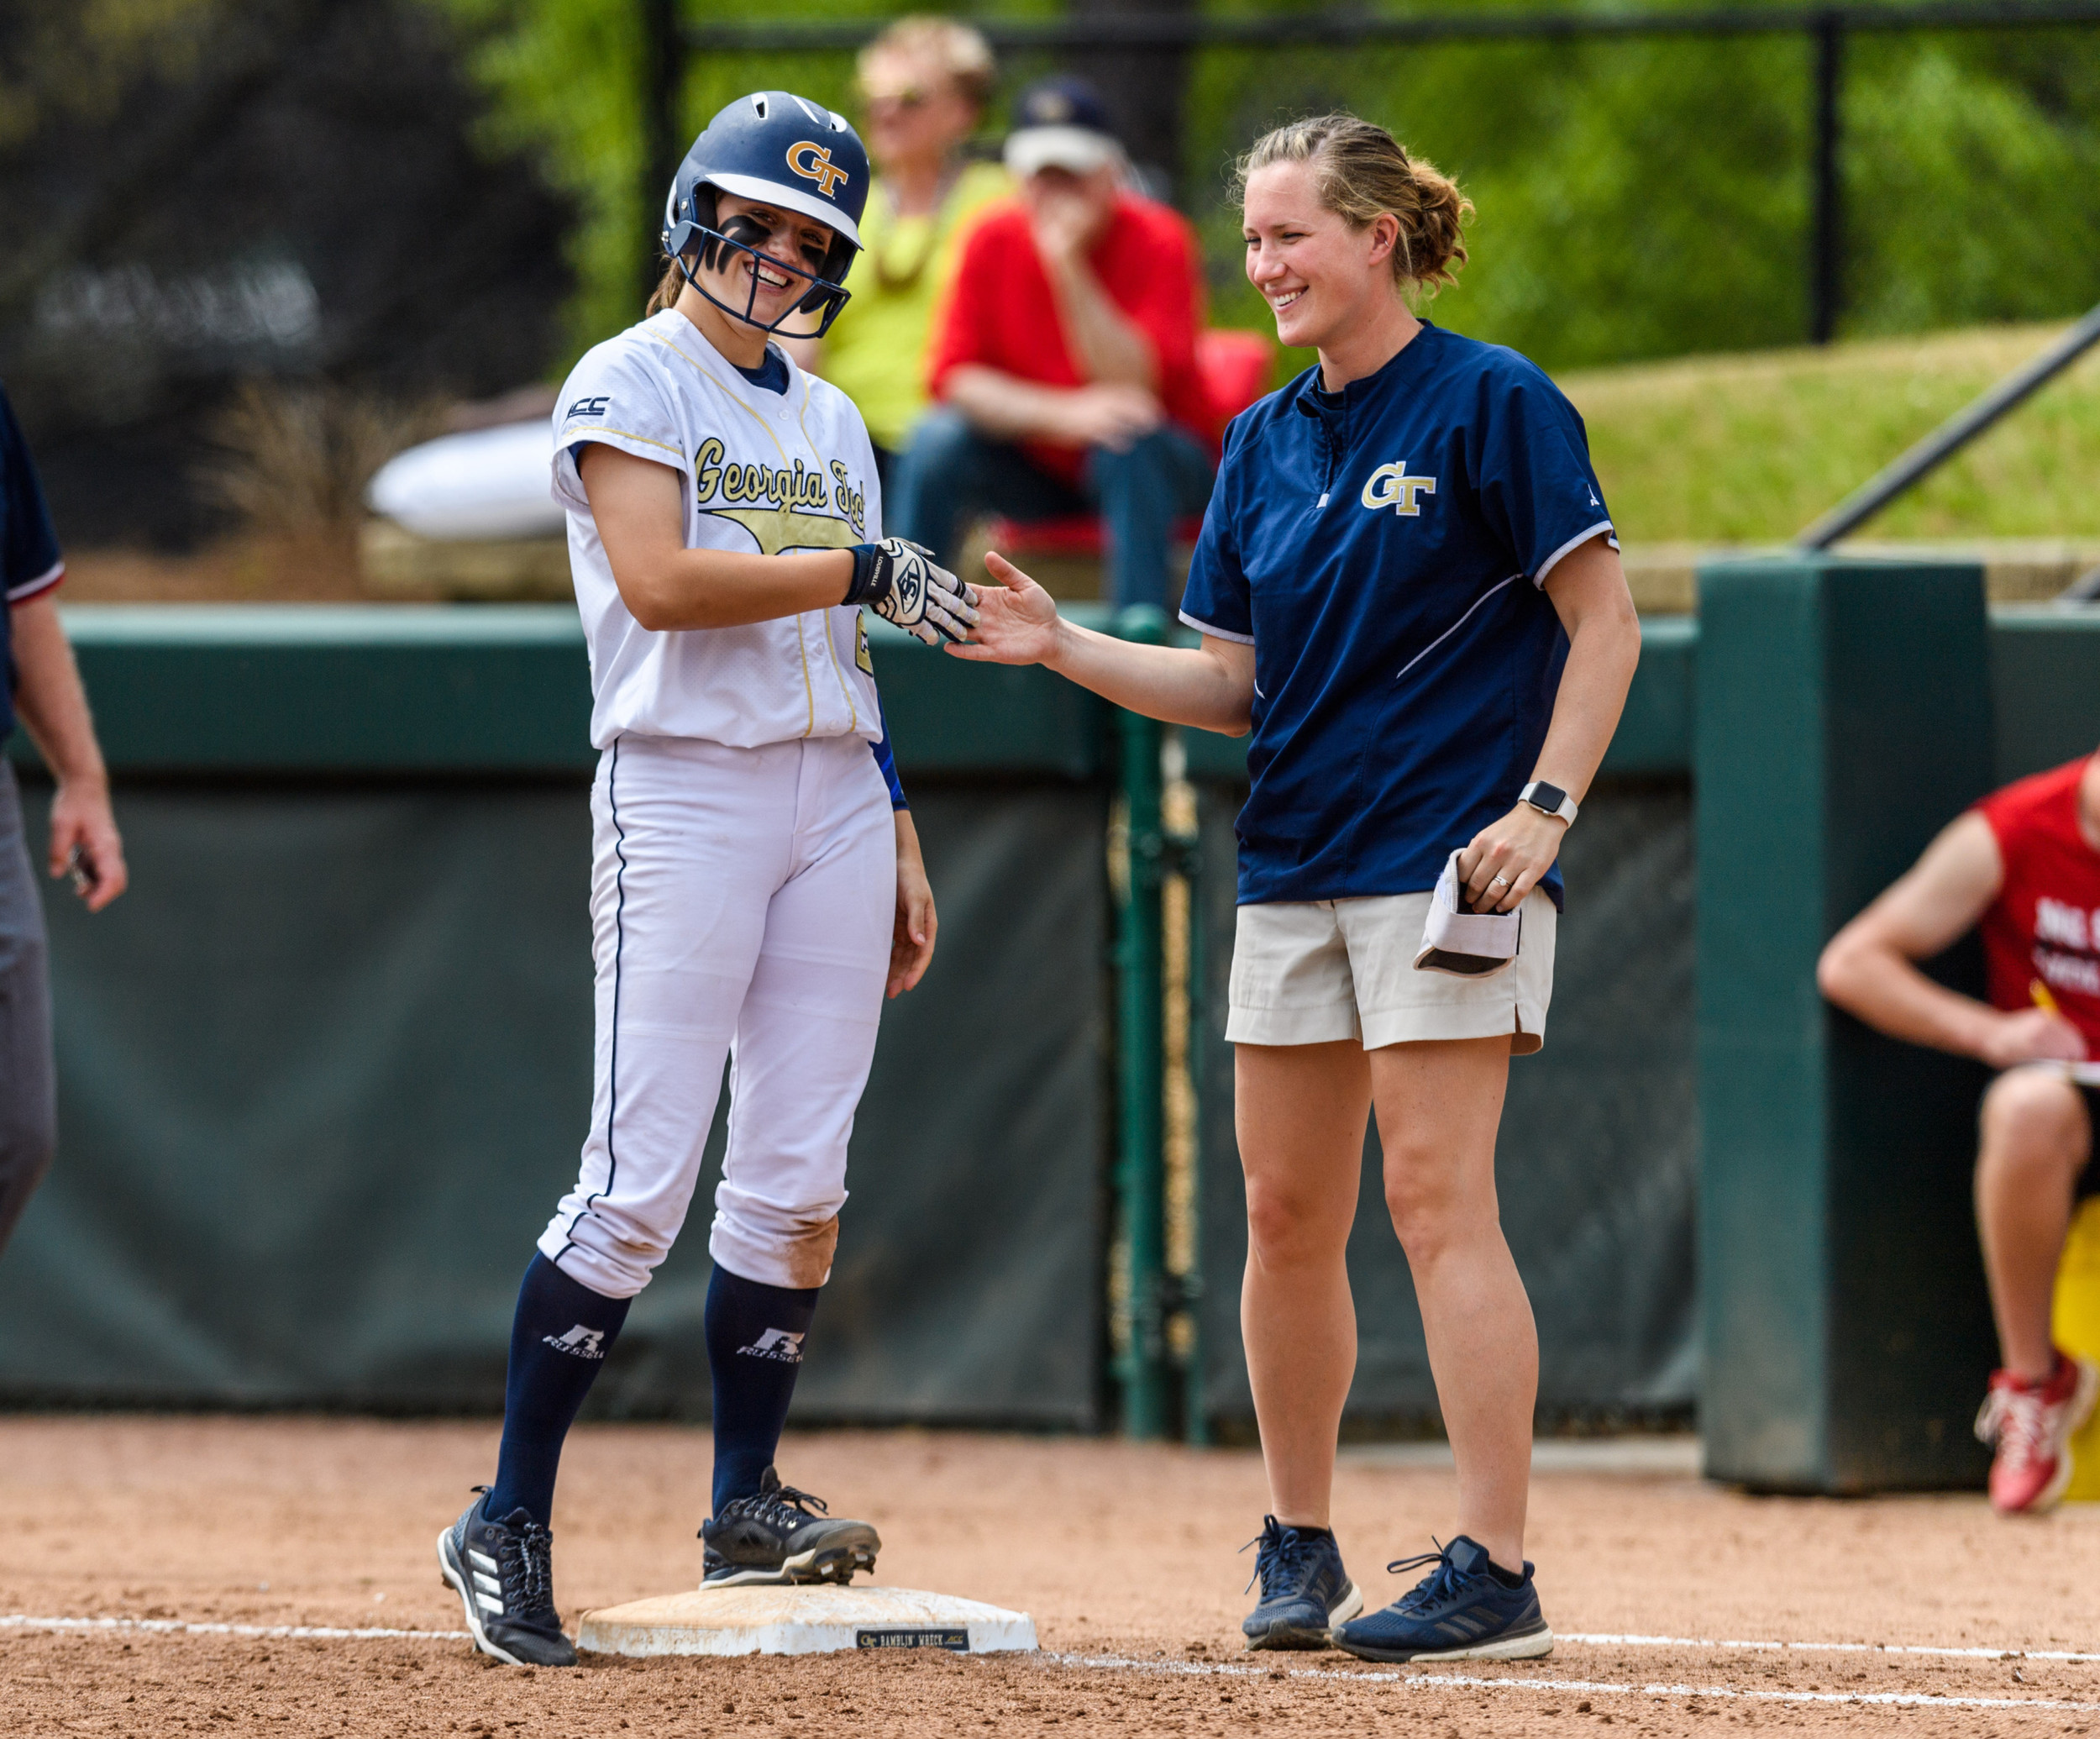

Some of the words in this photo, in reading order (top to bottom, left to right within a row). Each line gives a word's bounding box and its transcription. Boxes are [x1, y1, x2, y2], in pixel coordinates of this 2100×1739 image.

[786, 141, 849, 197] GT
[695, 437, 827, 513] Georgia
[1361, 460, 1436, 516] GT
[870, 555, 884, 587] LOUISVILLE
[880, 1634, 916, 1647] RAMBLIN'
[918, 1634, 943, 1646] WRECK
[945, 1635, 963, 1644] ACC
